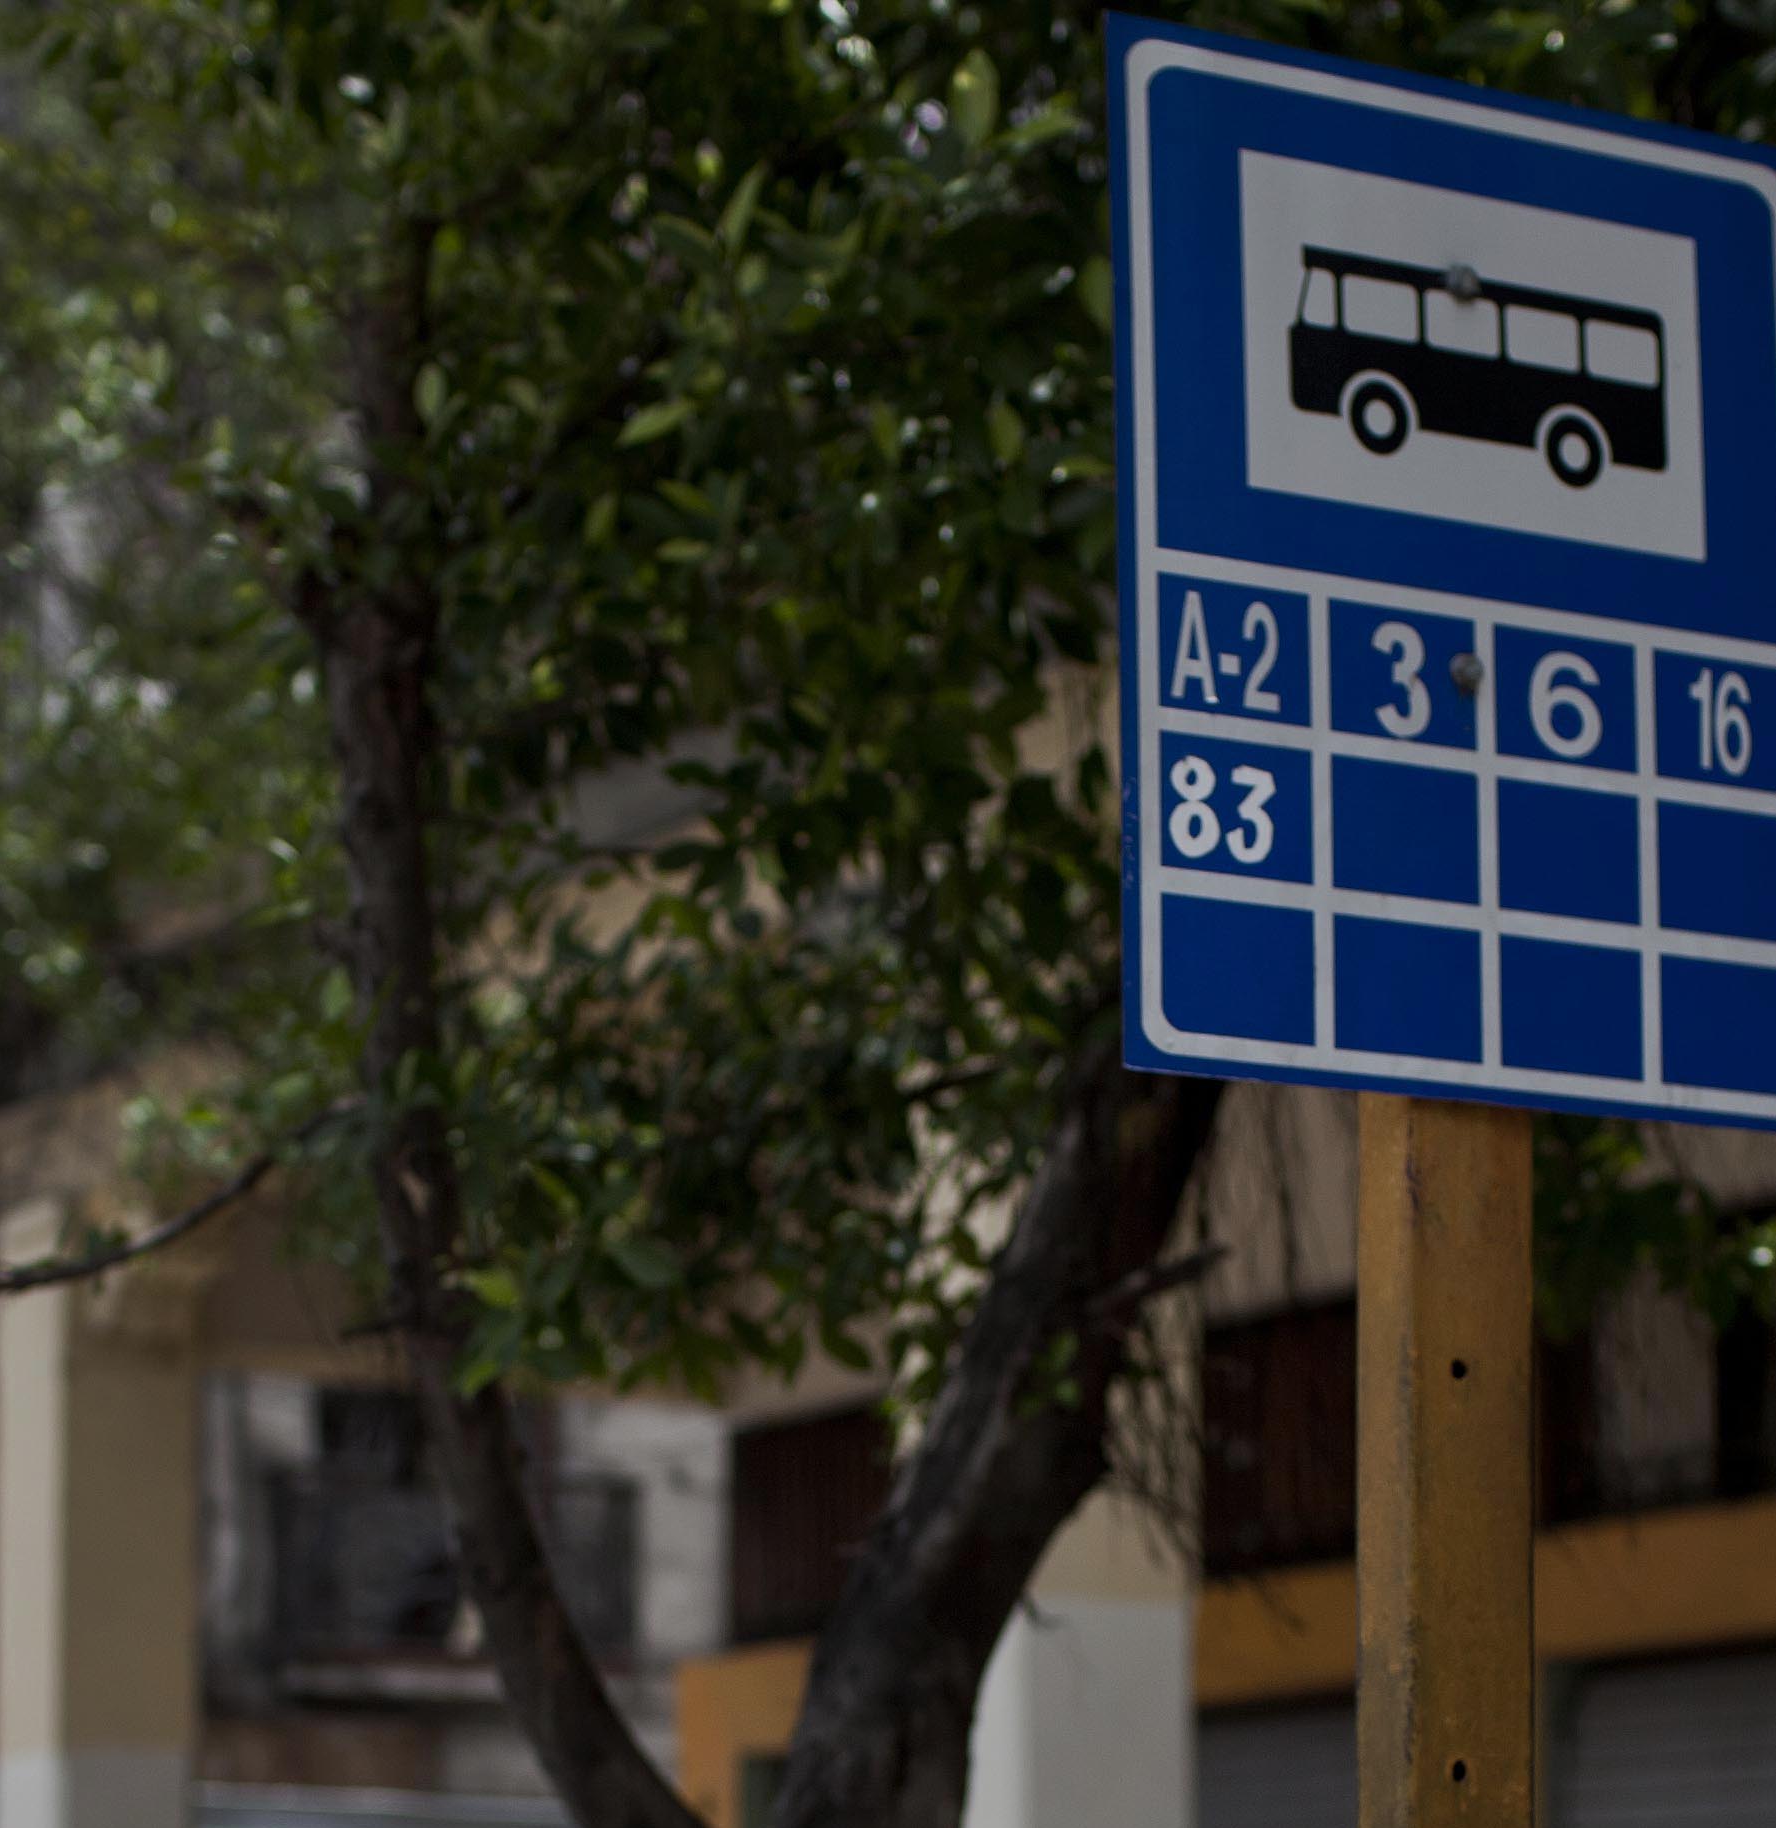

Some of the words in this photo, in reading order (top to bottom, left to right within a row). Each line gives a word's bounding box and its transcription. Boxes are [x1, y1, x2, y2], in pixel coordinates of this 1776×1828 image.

[1171, 590, 1281, 714] A-2
[1370, 620, 1432, 739] 3
[1528, 651, 1603, 759] 6
[1689, 667, 1752, 777] 16
[1168, 754, 1277, 865] 83
